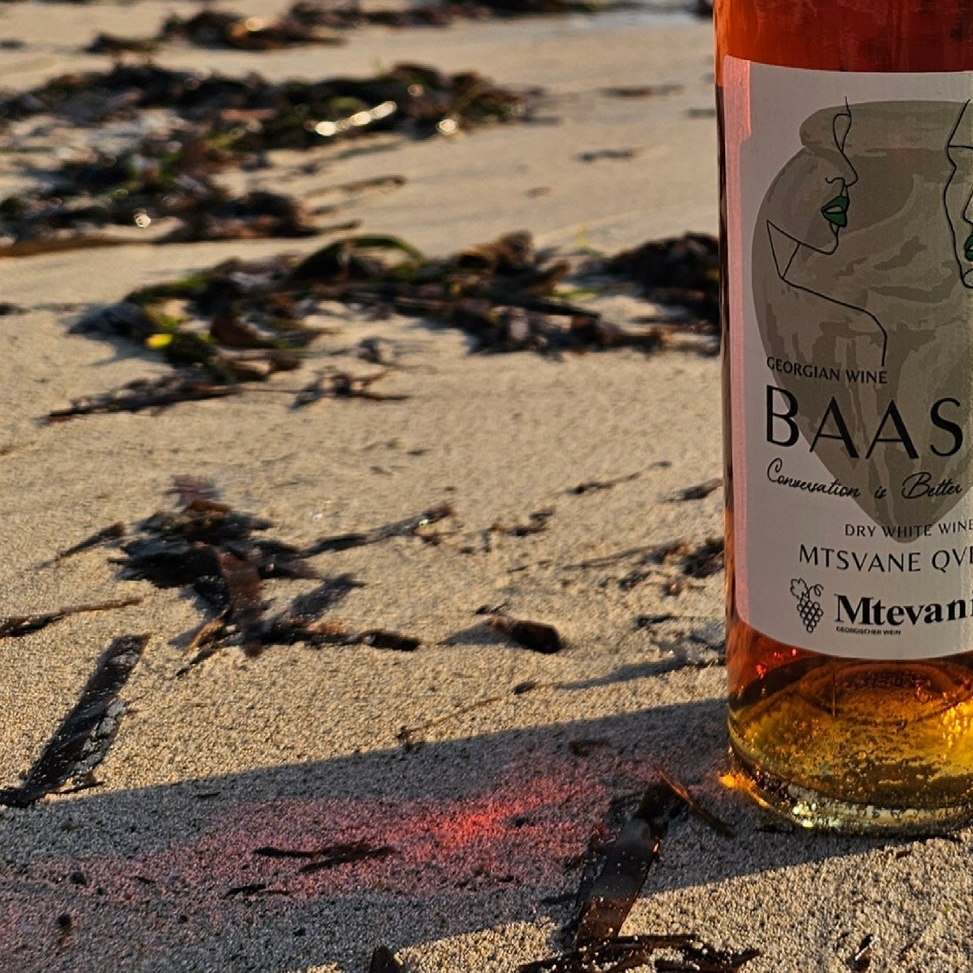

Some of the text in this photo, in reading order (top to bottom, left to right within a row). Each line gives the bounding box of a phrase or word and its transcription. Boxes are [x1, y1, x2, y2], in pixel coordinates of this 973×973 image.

[766, 356, 887, 384] GEORGIAN WINE
[767, 457, 861, 498] Conversation
[874, 486, 887, 499] is
[901, 471, 962, 499] Better
[845, 524, 876, 538] DRY
[882, 525, 932, 538] WHITE
[799, 544, 922, 572] MTSVANE
[836, 626, 882, 635] GEORGISCHER
